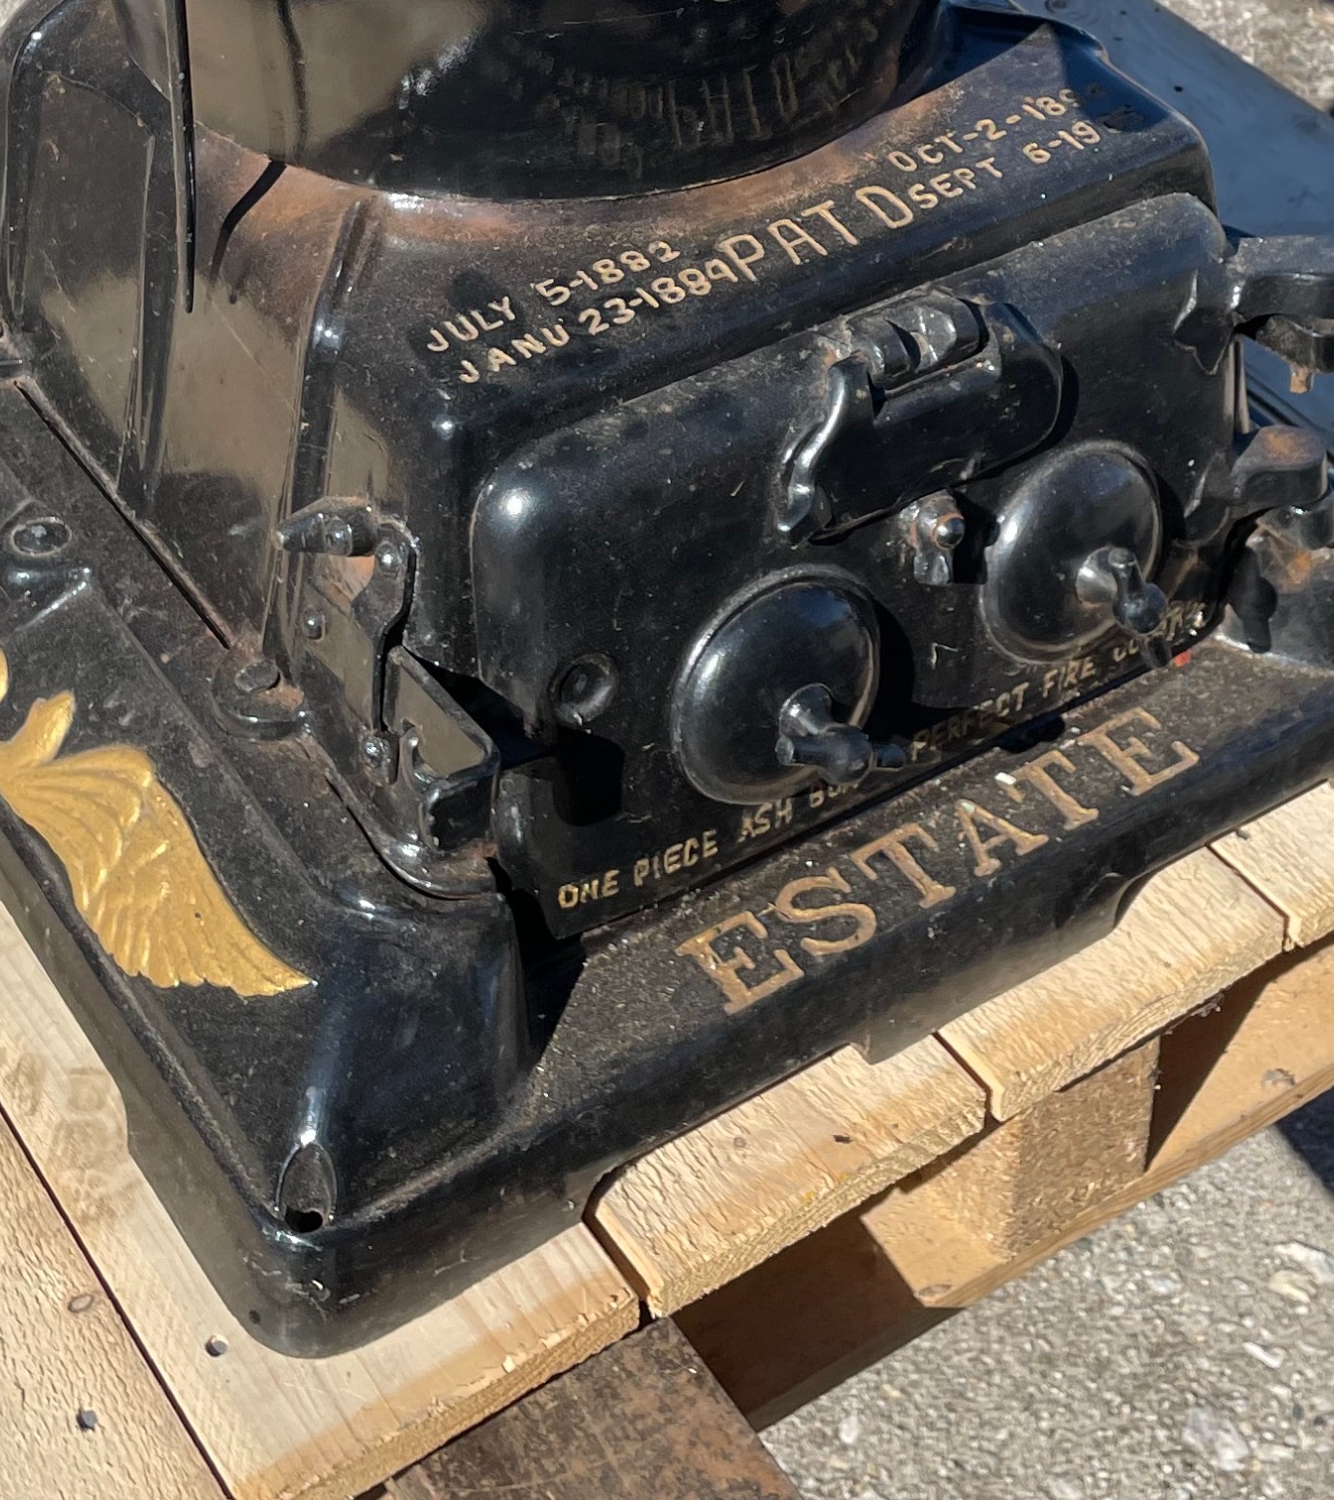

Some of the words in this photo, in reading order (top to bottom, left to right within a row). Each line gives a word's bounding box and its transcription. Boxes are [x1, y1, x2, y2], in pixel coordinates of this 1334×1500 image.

[908, 157, 1003, 209] SEPT
[718, 199, 859, 282] PAT
[855, 185, 914, 229] D
[427, 296, 516, 352] JULY
[558, 869, 619, 909] ONE
[633, 830, 718, 886] PIECE
[1042, 657, 1096, 698] FIRE
[675, 707, 1199, 1014] ESTATE
